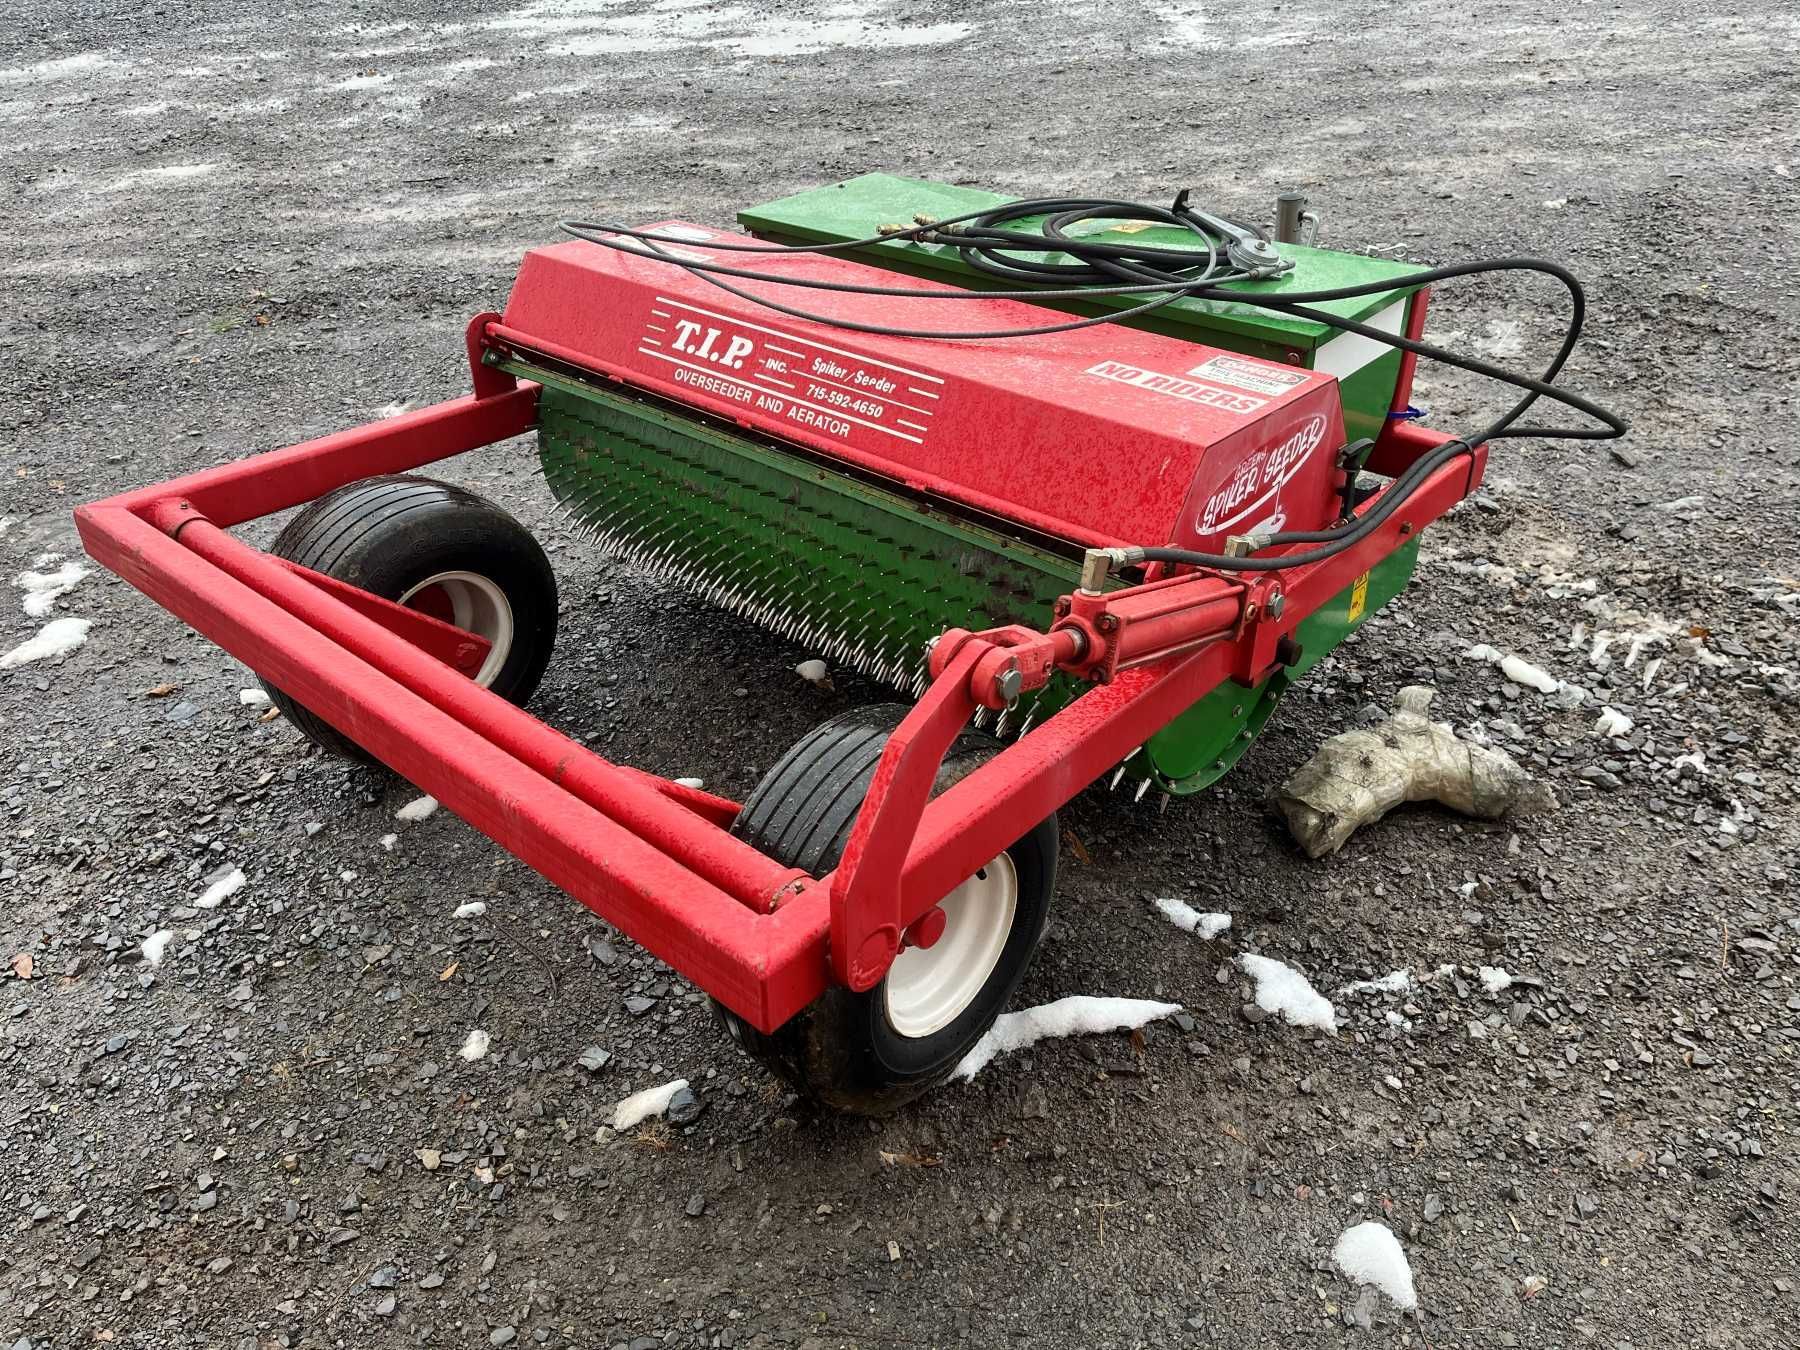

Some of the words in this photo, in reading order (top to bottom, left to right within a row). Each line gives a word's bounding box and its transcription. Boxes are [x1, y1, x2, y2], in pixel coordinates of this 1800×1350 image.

[672, 319, 754, 369] T.I.P.
[674, 368, 753, 404] OVERSEEDER
[756, 395, 784, 414] AND
[787, 405, 850, 438] AERATOR
[806, 383, 884, 418] 715-592-4650
[1096, 363, 1143, 382] NO
[1144, 375, 1259, 413] RIDERS
